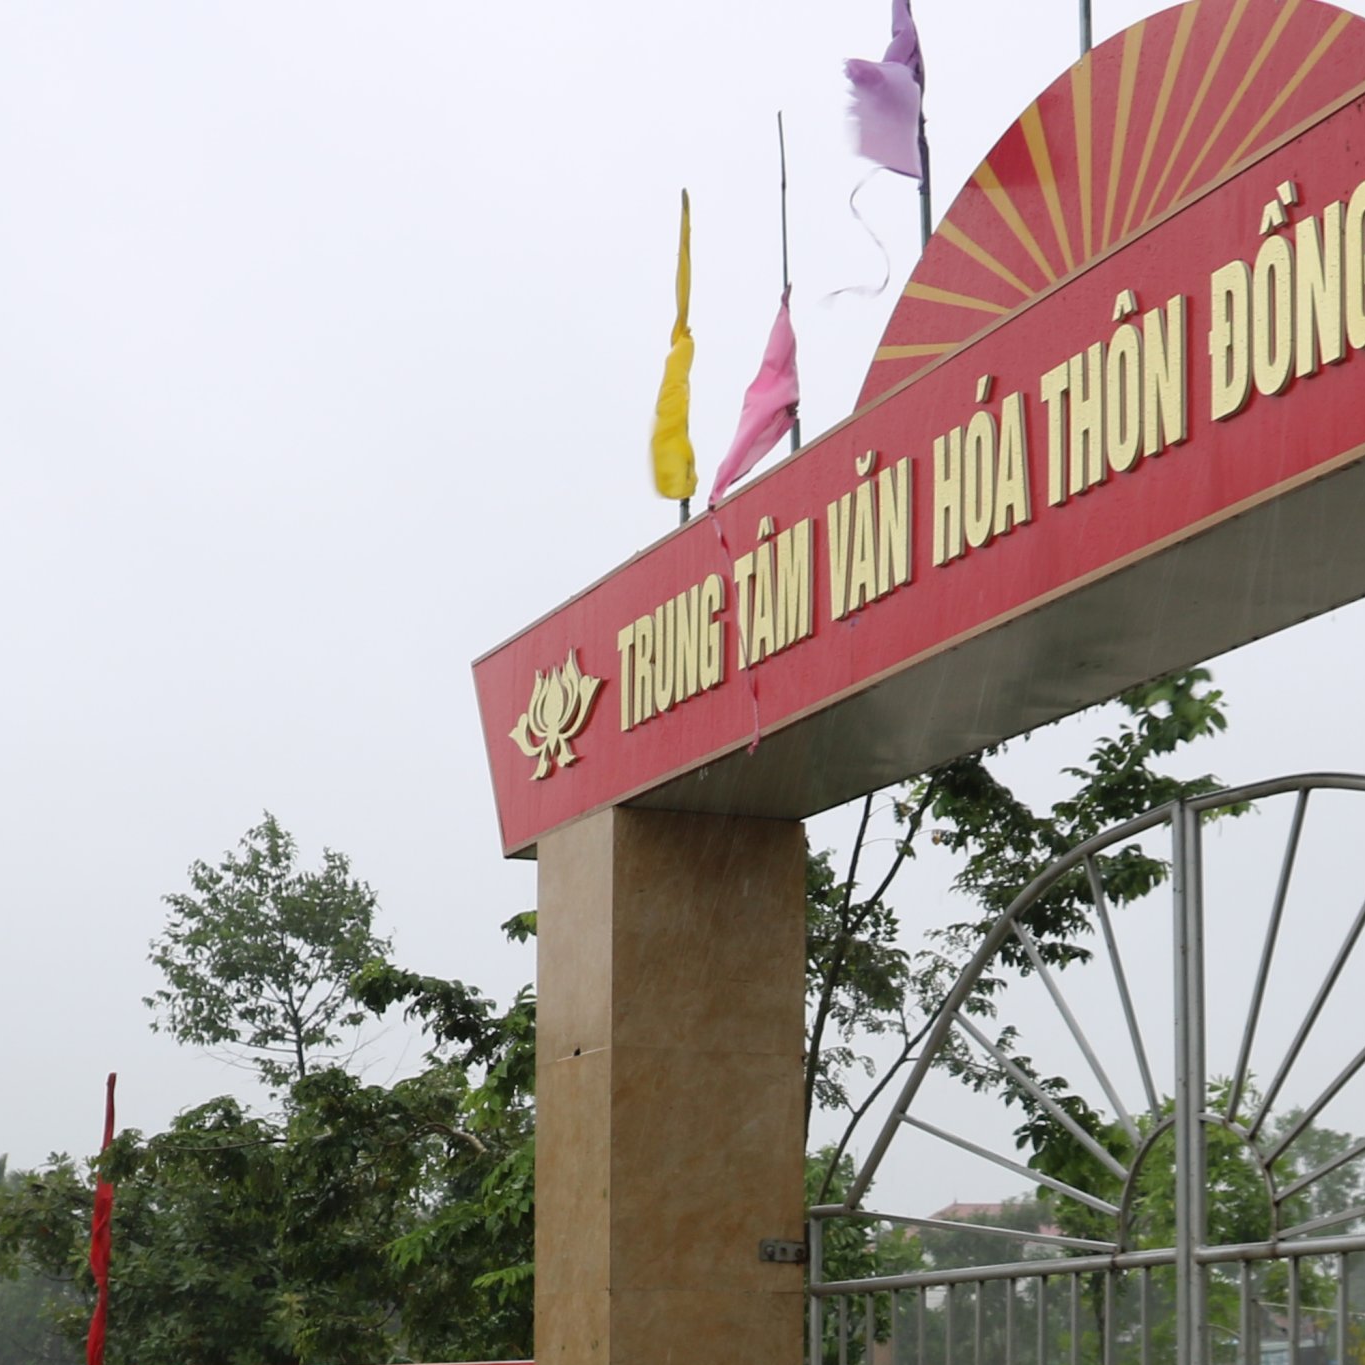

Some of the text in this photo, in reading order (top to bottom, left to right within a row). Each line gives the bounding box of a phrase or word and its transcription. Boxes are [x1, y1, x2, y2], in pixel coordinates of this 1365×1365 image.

[617, 573, 726, 733] TRUNG
[734, 515, 815, 671] TÂM
[827, 449, 914, 622] VĂN
[932, 374, 1033, 568] HÓA
[1040, 289, 1187, 507] THÔN
